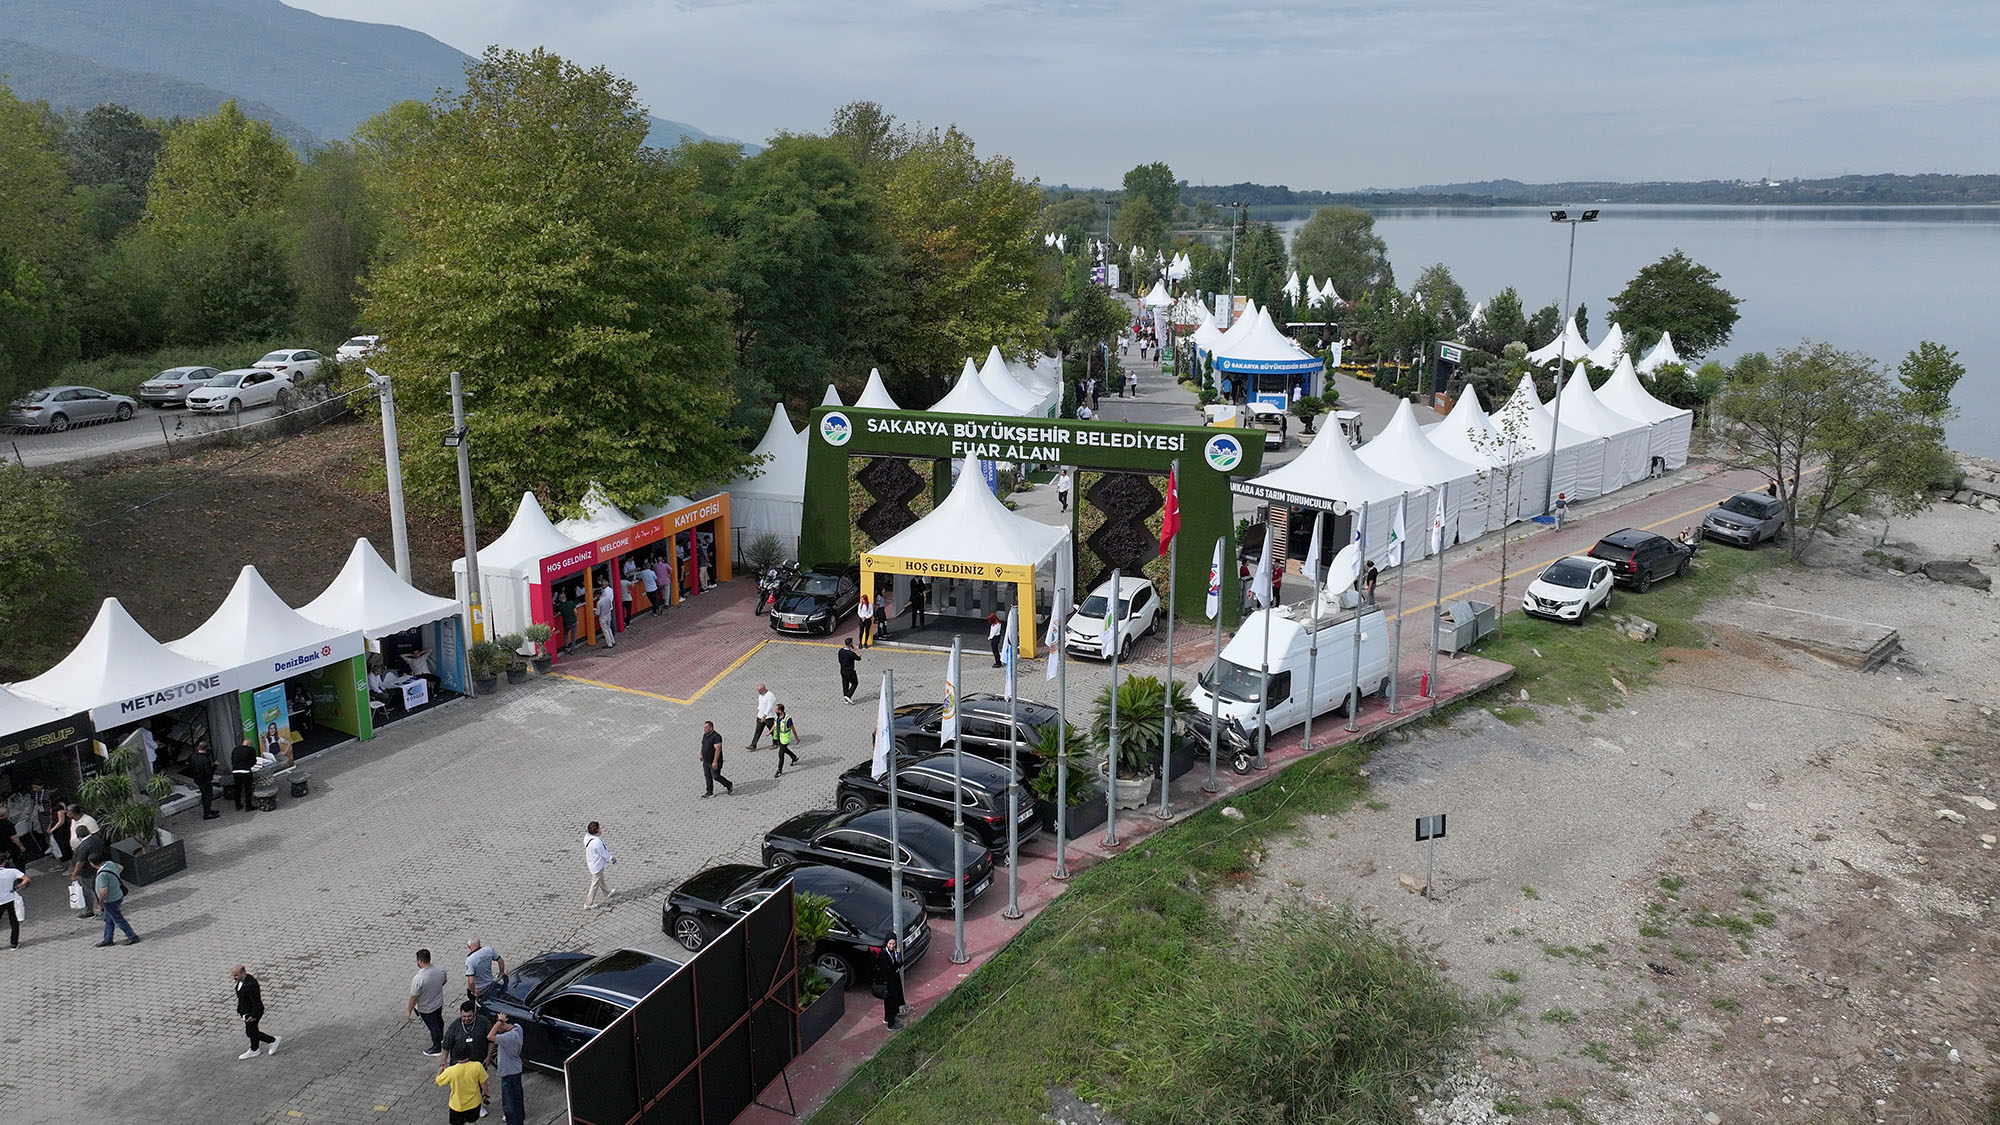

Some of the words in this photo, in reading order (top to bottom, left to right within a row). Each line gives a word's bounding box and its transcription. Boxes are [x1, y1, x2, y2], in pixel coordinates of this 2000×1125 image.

[867, 418, 949, 437] SAKARYA
[953, 421, 1070, 444] BÜYÜKŞEHİR
[1076, 430, 1185, 451] BELEDİYESİ
[952, 441, 1001, 459] FUAR
[1005, 444, 1060, 462] ALANI
[1265, 488, 1285, 502] TARIM
[1286, 493, 1333, 512] TOHUMCULUK
[674, 510, 698, 528] KAYIT
[699, 500, 720, 518] OFİSİ
[600, 537, 629, 553] WELCOME
[546, 562, 561, 574] HOŞ
[562, 550, 592, 568] GELDİNİZ
[905, 561, 928, 574] HOŞ
[931, 562, 985, 577] GELDİNİZ
[274, 651, 320, 673] DenizBank
[120, 675, 221, 715] METASTONE
[24, 726, 75, 751] GRUP
